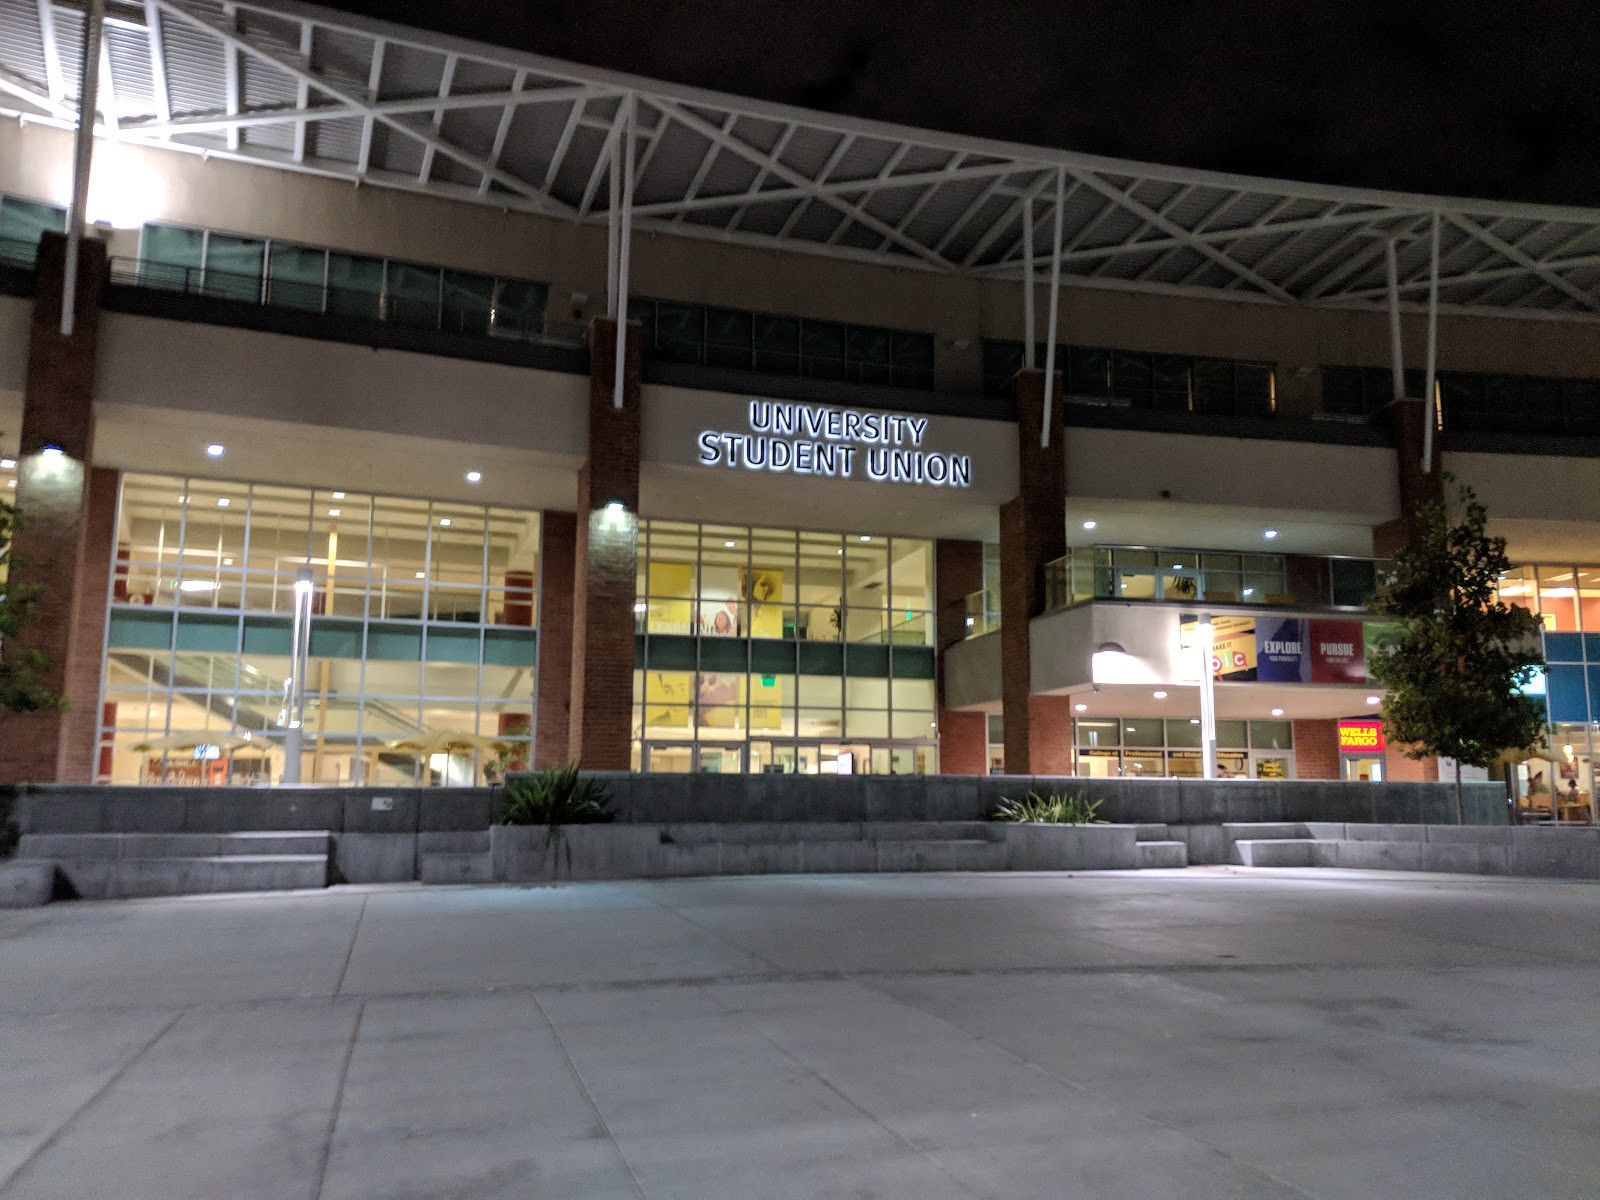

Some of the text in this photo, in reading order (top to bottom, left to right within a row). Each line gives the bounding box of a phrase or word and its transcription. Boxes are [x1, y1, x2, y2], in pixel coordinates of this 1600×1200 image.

[749, 400, 928, 446] UNIVERSITY
[699, 430, 972, 487] STUDENT UNION
[1264, 641, 1302, 654] EXPLORE
[1320, 643, 1354, 656] PURSUE
[1340, 727, 1377, 737] WELLS
[1341, 736, 1378, 746] FARGO
